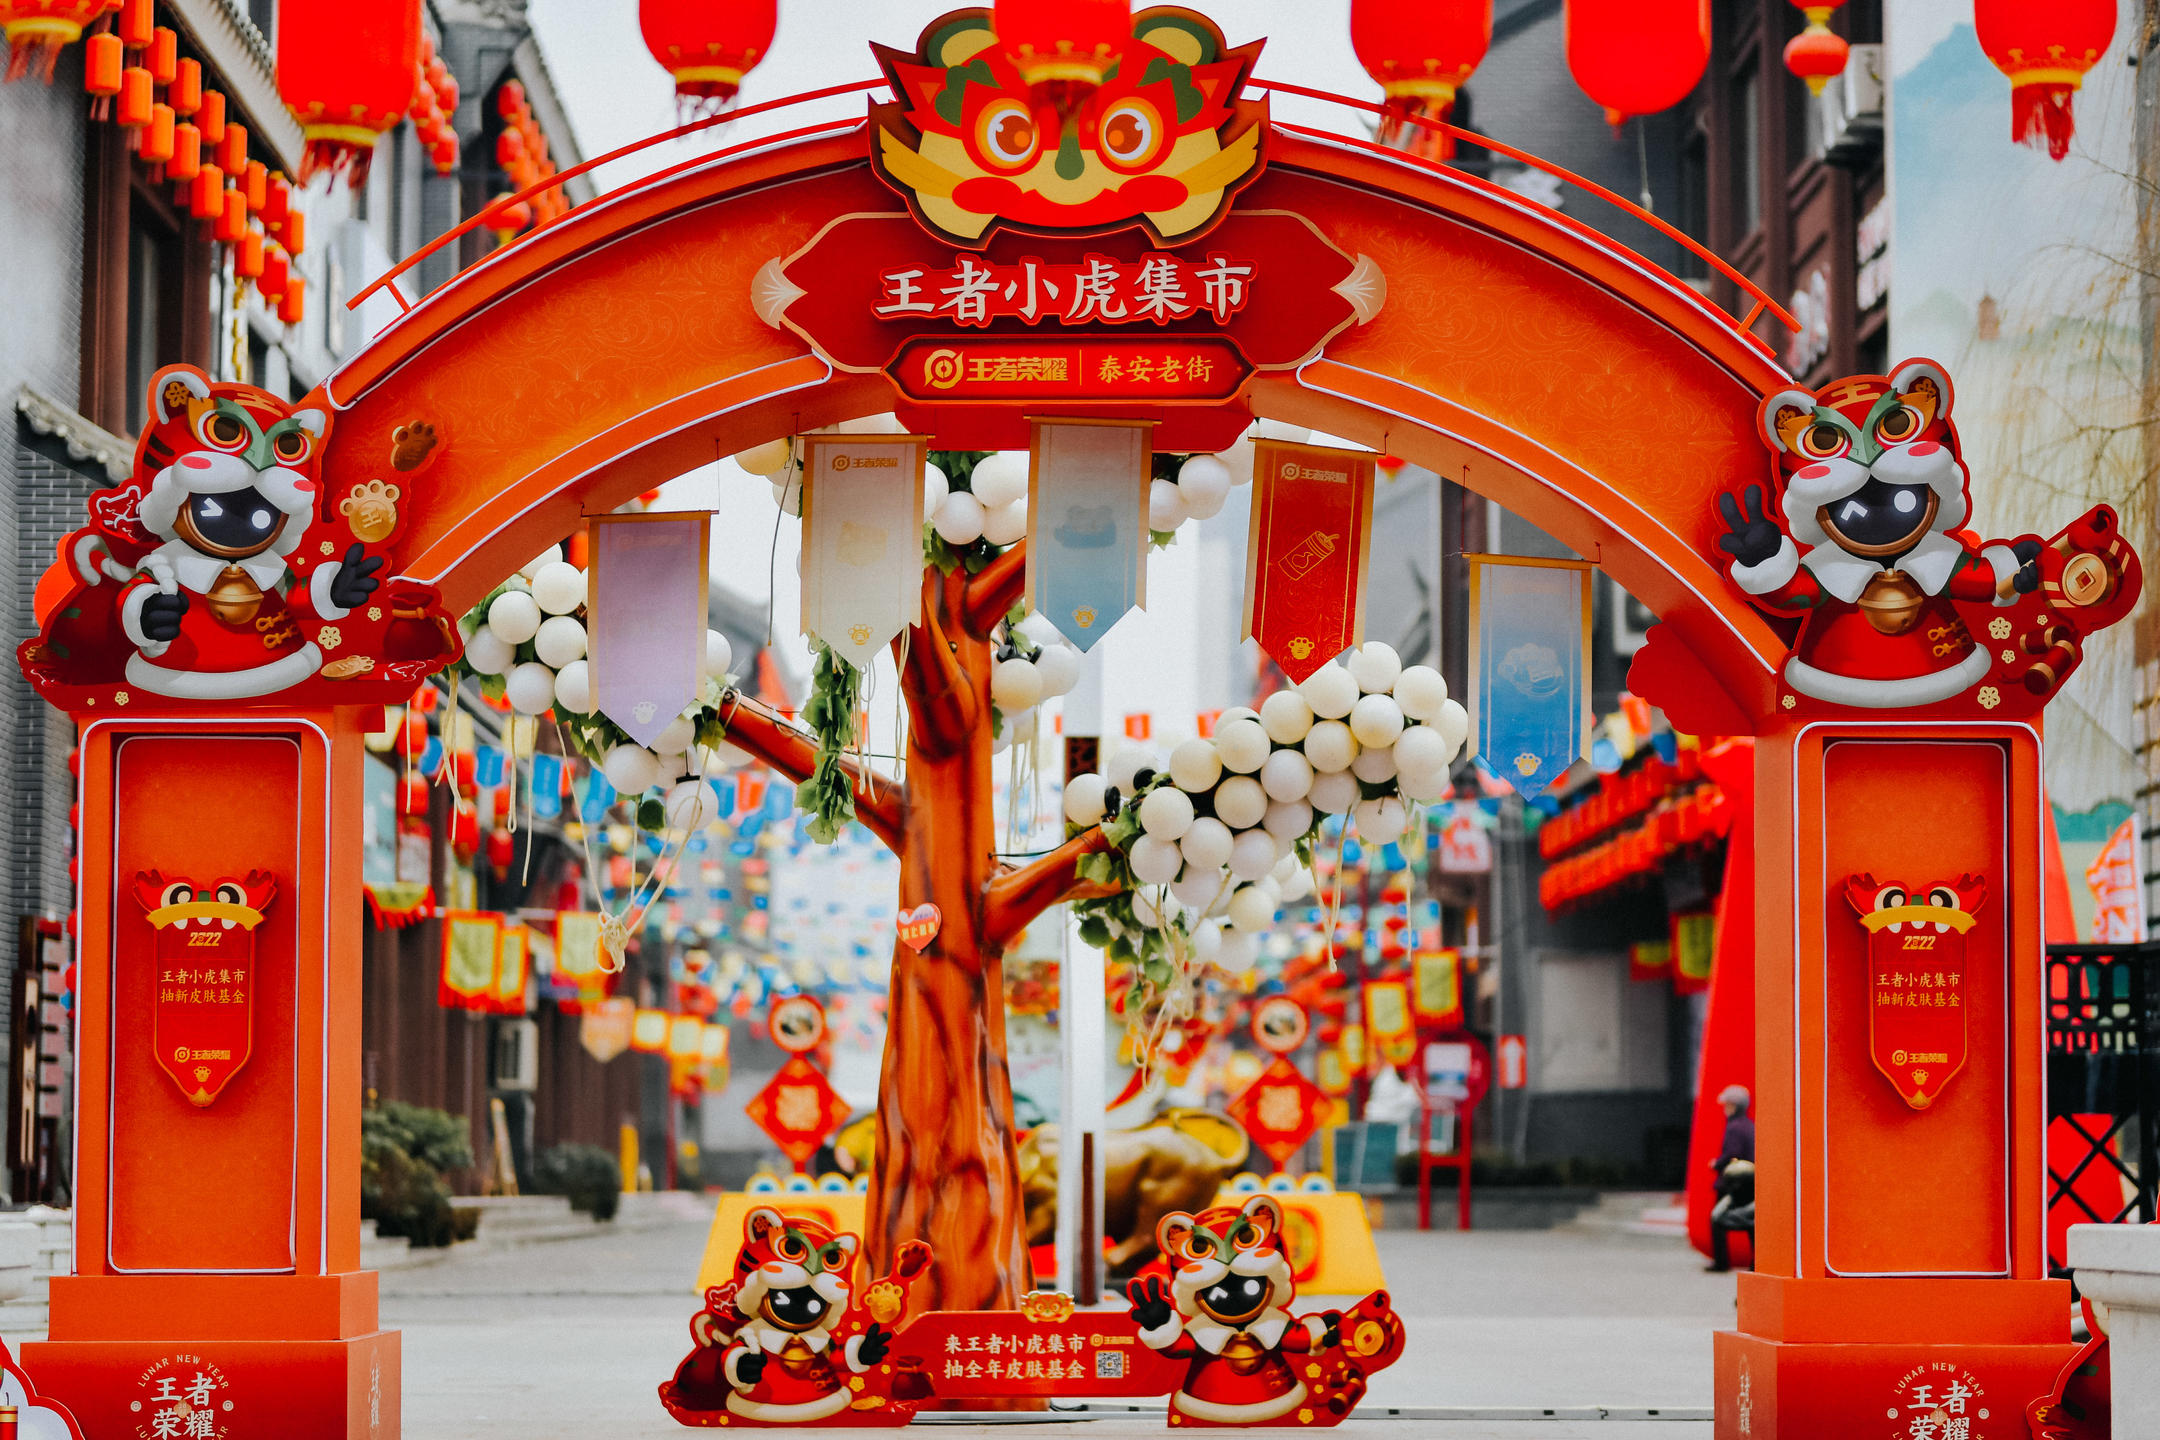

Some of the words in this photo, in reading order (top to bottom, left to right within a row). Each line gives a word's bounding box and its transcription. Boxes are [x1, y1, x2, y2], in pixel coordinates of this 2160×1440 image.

[875, 257, 1252, 321] 王者小虎集市
[966, 357, 1069, 382] 王者荣耀
[1097, 354, 1214, 383] 泰安老街
[160, 968, 246, 985] 王者小虎集市
[1876, 972, 1961, 988] 王者小虎集市
[160, 988, 245, 1004] 抽新皮肤基金
[1876, 991, 1960, 1007] 抽新皮肤基金
[944, 1333, 1087, 1354] 来王者小虎集市
[137, 1357, 170, 1388] LUNAR
[176, 1354, 201, 1365] NEW
[206, 1362, 229, 1389] YEAR
[943, 1358, 1087, 1379] 抽全年皮肤基金
[1893, 1365, 1926, 1395] LUNAR
[1932, 1362, 1957, 1373] NEW
[1962, 1370, 1985, 1398] YEAR
[150, 1371, 217, 1407] 王者
[1906, 1379, 1973, 1415] 王者
[151, 1407, 216, 1440] 荣耀
[1908, 1415, 1970, 1440] 荣耀
